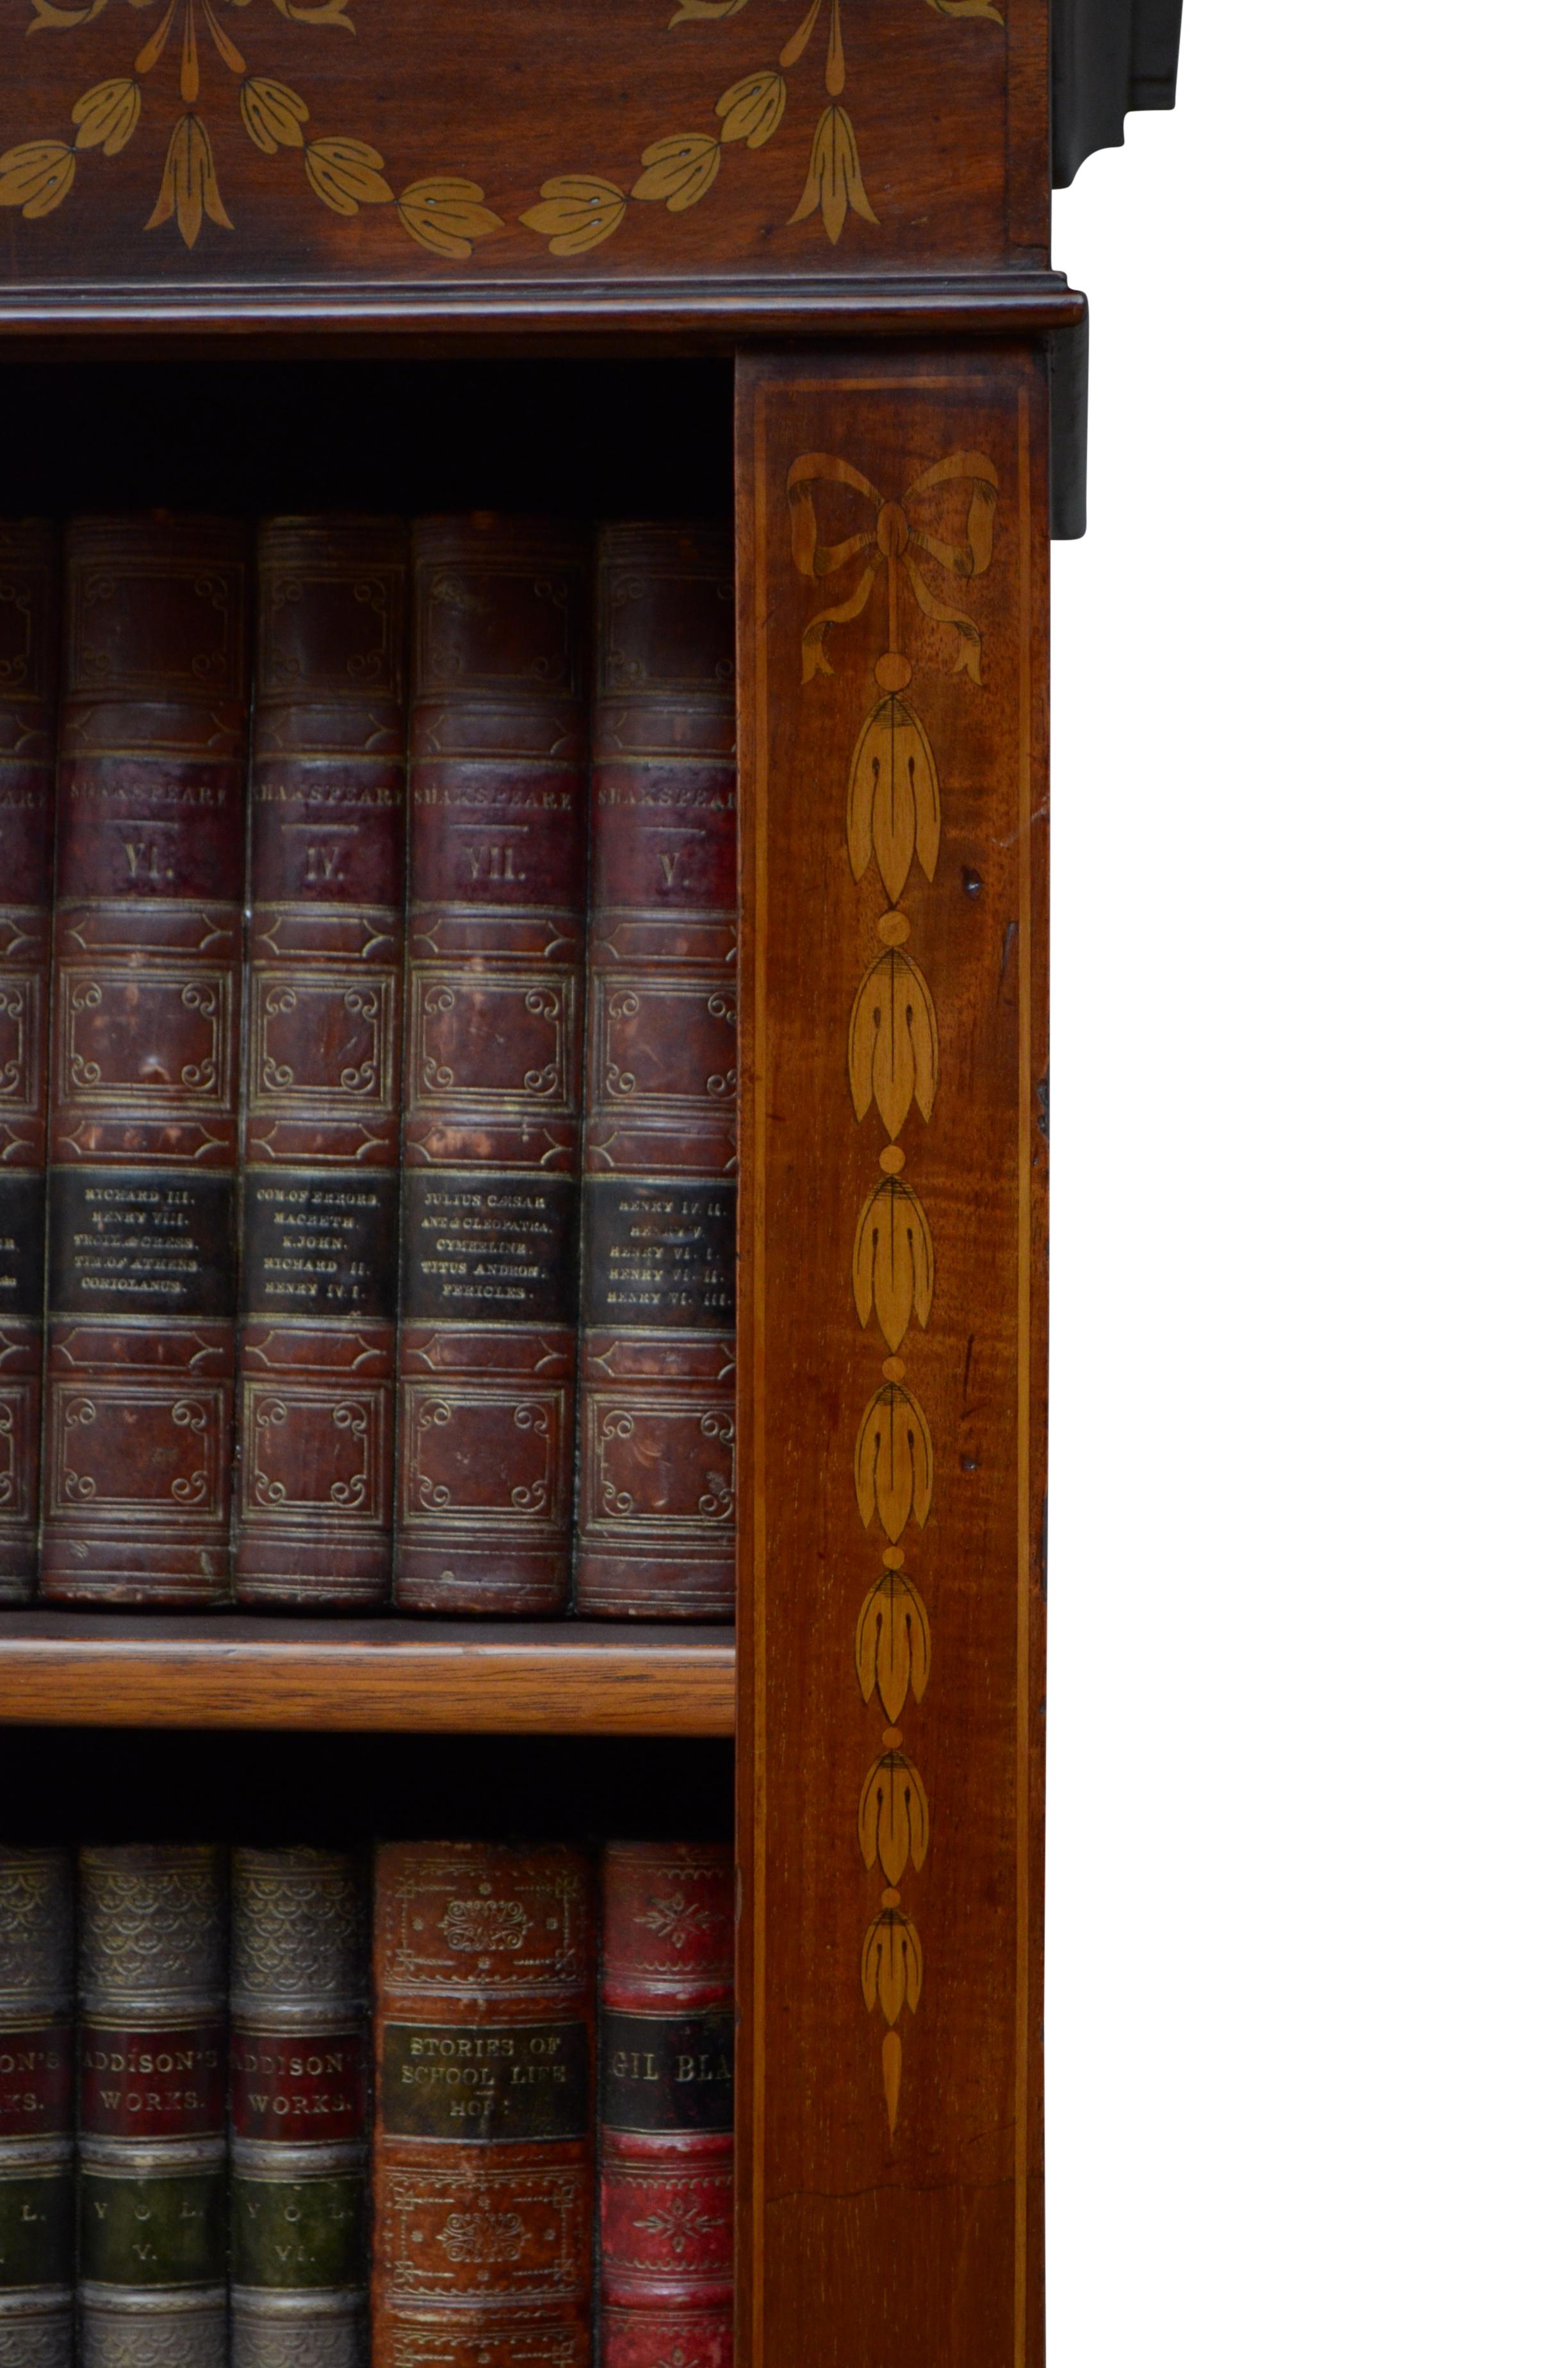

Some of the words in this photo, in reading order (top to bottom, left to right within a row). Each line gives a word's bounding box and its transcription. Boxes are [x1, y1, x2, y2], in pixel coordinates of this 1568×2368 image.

[123, 842, 176, 880] VI.
[305, 846, 346, 882] IV.
[461, 845, 527, 882] VII.
[656, 851, 690, 887] V.
[85, 1188, 160, 1203] RICHARD
[167, 1190, 195, 1206] III.
[424, 1193, 482, 1207] JULIUS
[619, 1200, 674, 1214] HENRY
[92, 1210, 147, 1224] HENRY
[263, 1257, 339, 1273] RICHARD
[421, 1260, 468, 1274] TITUS
[608, 1267, 664, 1282] HENRY
[81, 1276, 188, 1294] CORIOLANUS.
[265, 1281, 318, 1296] HENRY
[442, 1283, 534, 1301] PERICLES.
[606, 1290, 661, 1306] HENRY
[409, 2036, 515, 2057] STORIES
[529, 2037, 562, 2055] OF
[85, 2050, 218, 2073] ADDISON'S
[612, 2051, 660, 2081] GIL
[674, 2053, 733, 2083] BLA
[400, 2064, 496, 2086] SCHOOL
[510, 2064, 568, 2084] LIFE
[99, 2091, 207, 2112] WORKS.
[247, 2092, 354, 2116] WORKS.
[131, 2243, 158, 2261] V.
[274, 2244, 316, 2262] VI.
